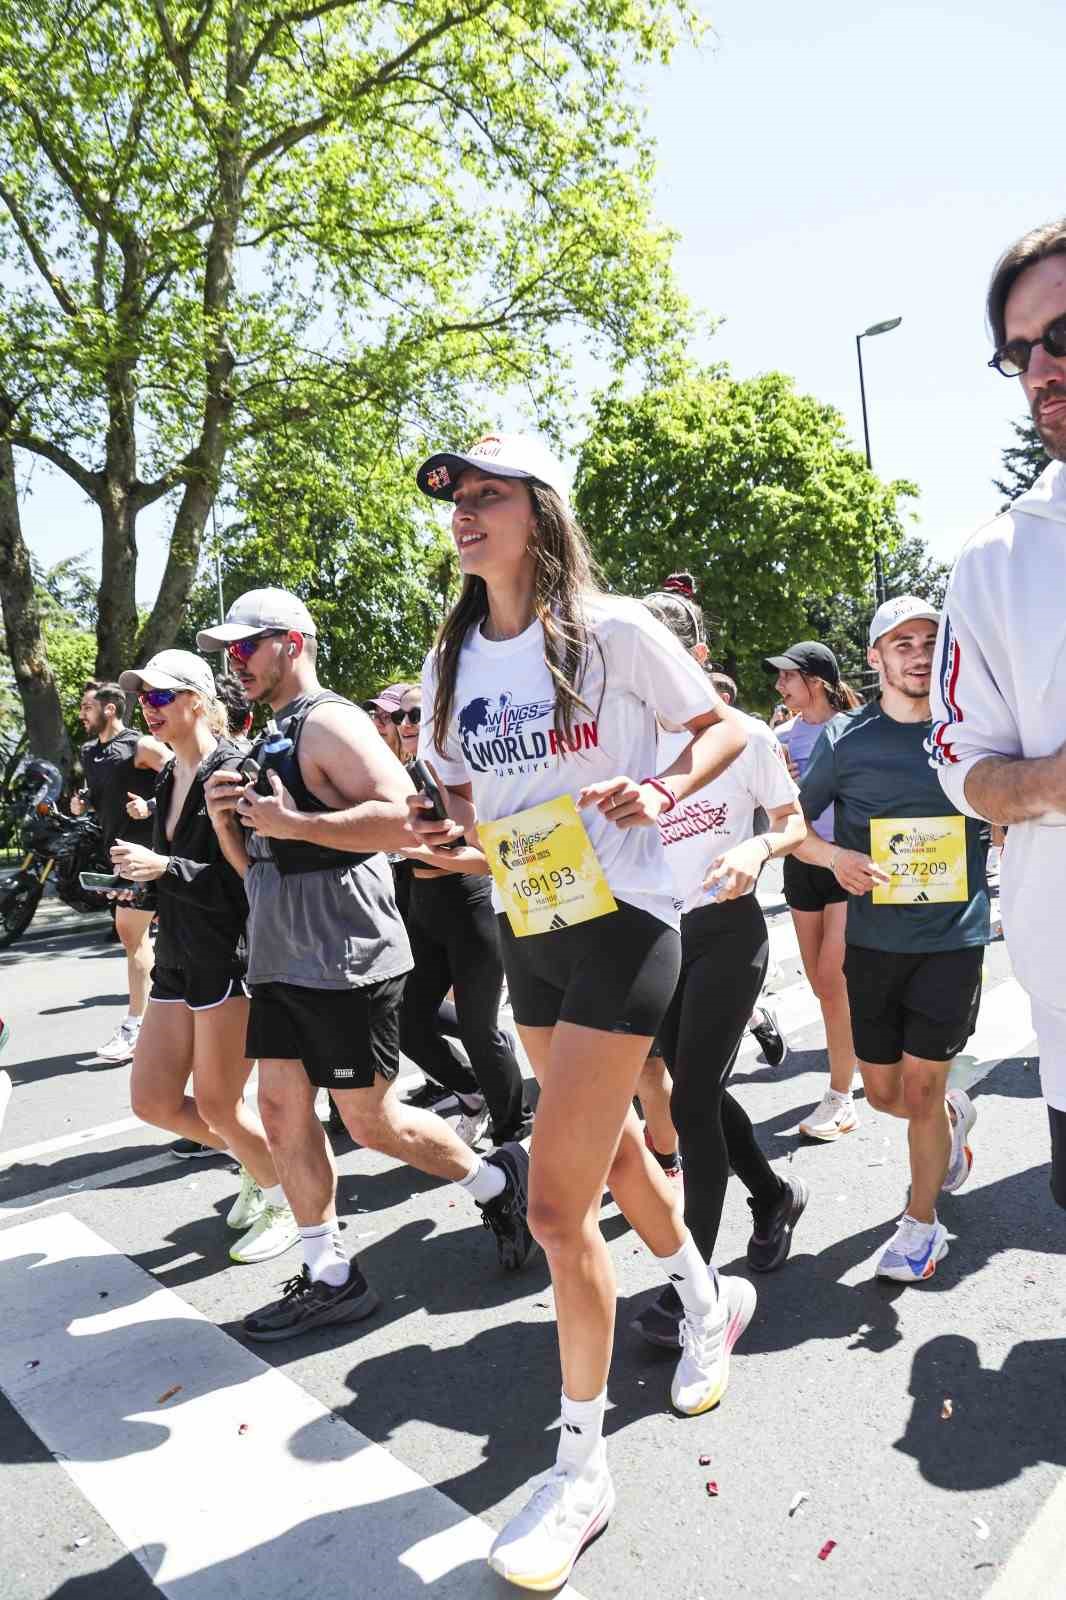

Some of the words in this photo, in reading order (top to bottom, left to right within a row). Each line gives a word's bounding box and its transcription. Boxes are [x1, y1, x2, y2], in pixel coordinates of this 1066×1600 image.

[487, 704, 539, 726] WINGS
[496, 720, 524, 738] LIFE
[890, 861, 948, 876] 227209
[512, 865, 577, 899] 169193
